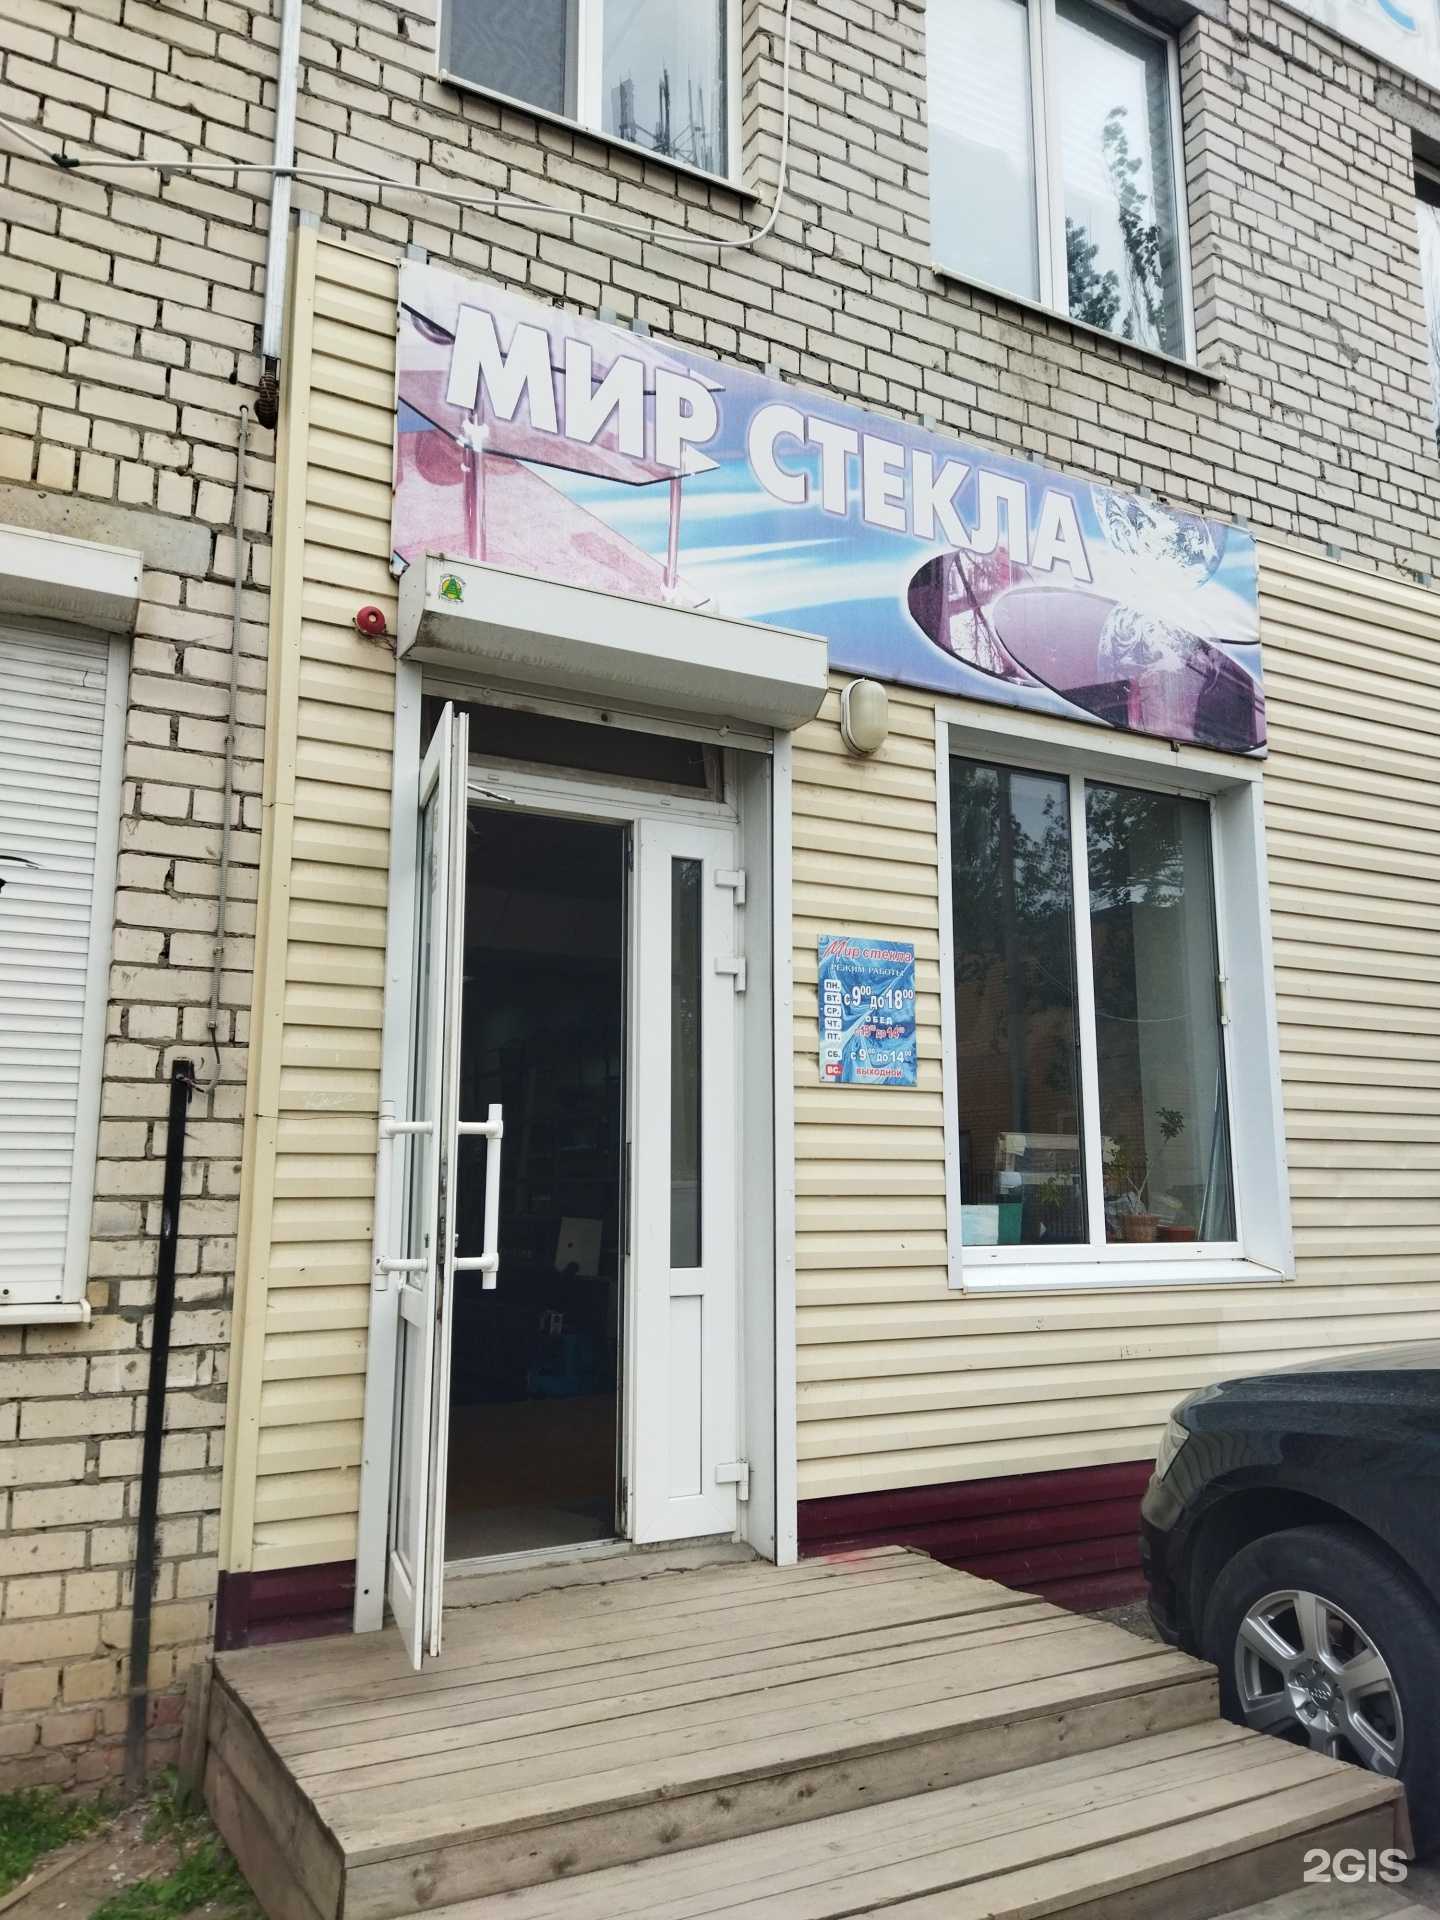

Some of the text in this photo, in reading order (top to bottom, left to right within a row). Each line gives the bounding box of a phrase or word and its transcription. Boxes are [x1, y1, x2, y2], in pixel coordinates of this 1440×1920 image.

[445, 303, 1094, 583] МИР СТЕКЛА
[823, 940, 912, 963] Мир стекла
[831, 963, 905, 977] РЕЖИМ РАБОТЫ
[826, 981, 841, 989] ПН.
[826, 994, 840, 1002] ВТ.
[870, 996, 885, 1011] до
[827, 1007, 840, 1016] СР.
[827, 1020, 840, 1028] ЧТ.
[865, 1015, 893, 1025] ОБЕД
[827, 1050, 840, 1058] СБ.
[877, 1053, 888, 1063] до
